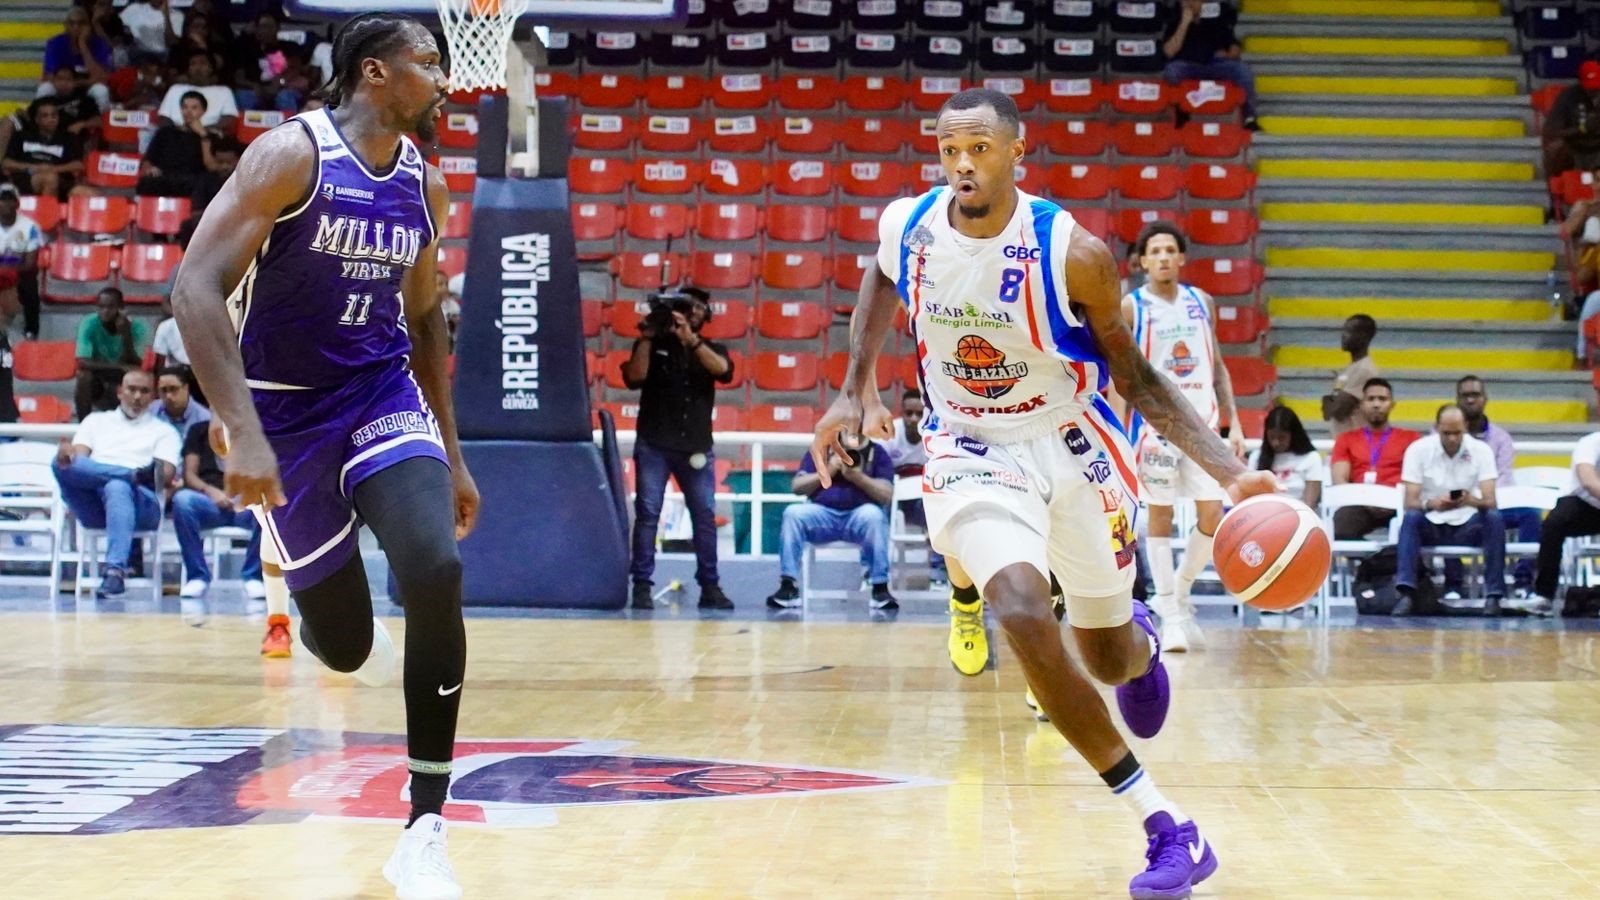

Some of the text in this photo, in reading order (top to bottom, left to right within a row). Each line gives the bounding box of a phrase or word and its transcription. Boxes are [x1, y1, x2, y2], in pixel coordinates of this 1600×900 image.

[309, 212, 421, 267] MILLON
[1003, 246, 1041, 261] GBC
[999, 268, 1025, 303] 8
[338, 292, 373, 325] 11
[494, 232, 540, 389] REPÚBLICA
[930, 314, 971, 329] Energía
[970, 361, 1028, 380] LAZARO
[502, 396, 539, 409] CERVEZA
